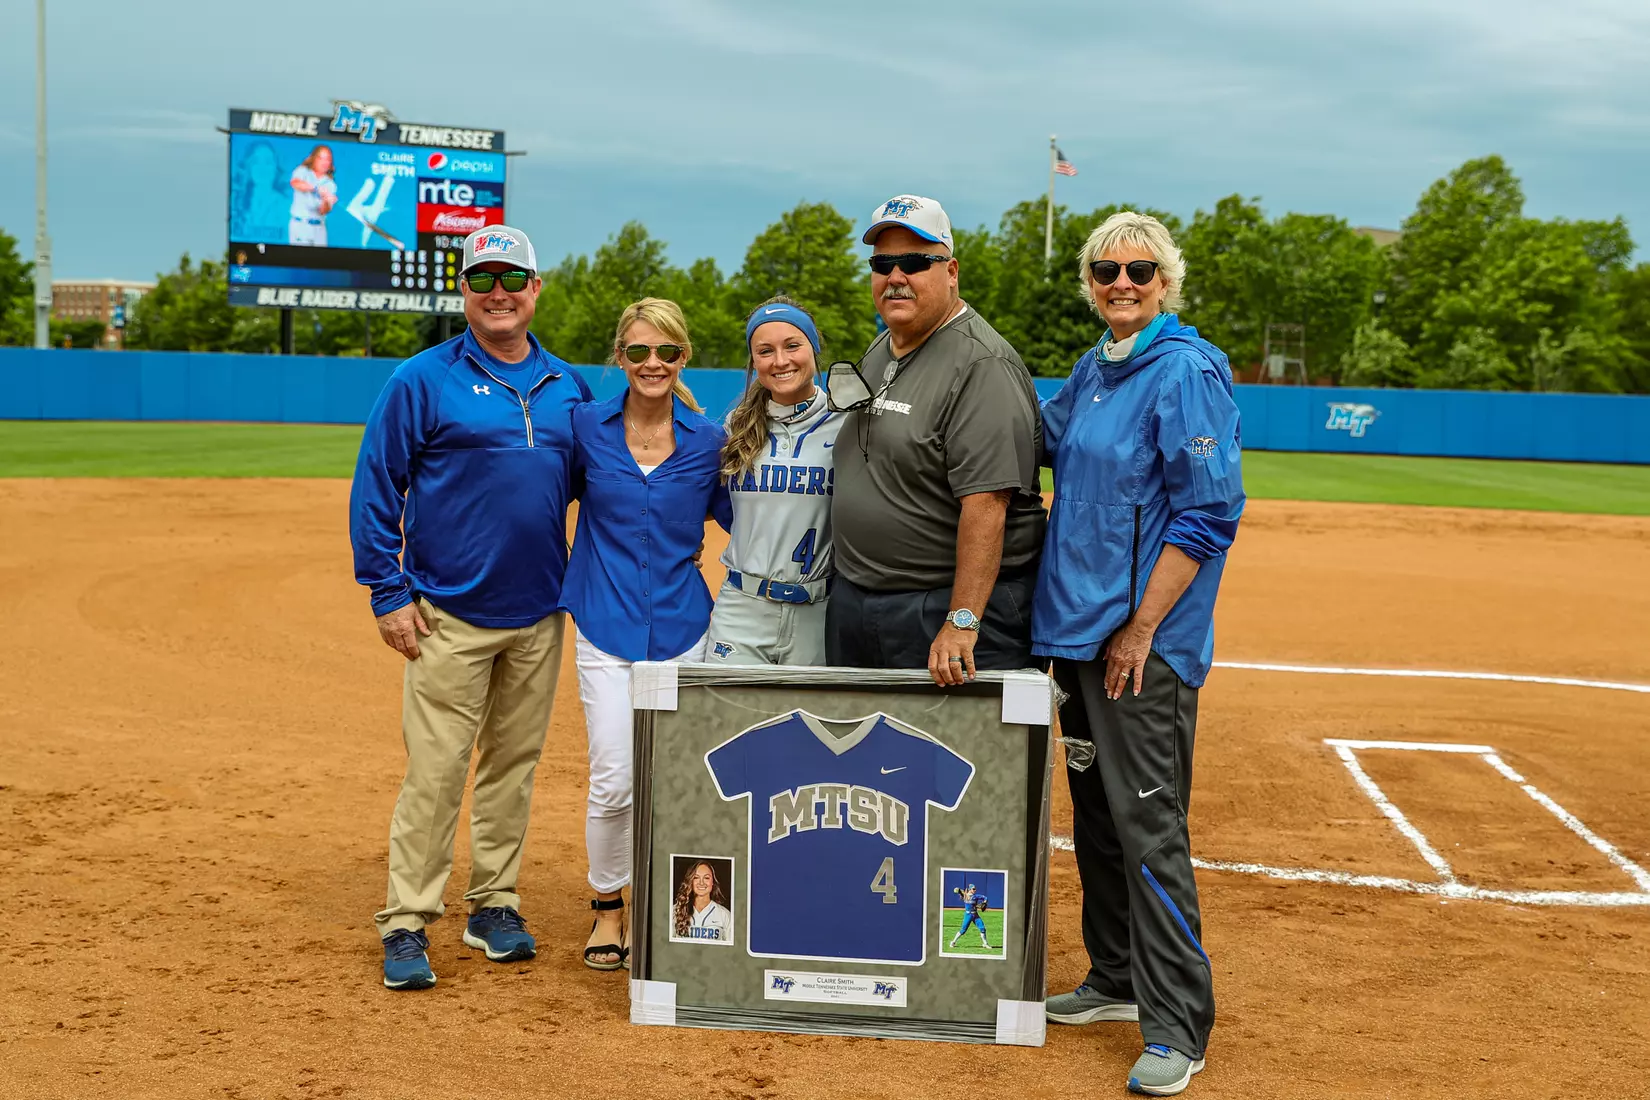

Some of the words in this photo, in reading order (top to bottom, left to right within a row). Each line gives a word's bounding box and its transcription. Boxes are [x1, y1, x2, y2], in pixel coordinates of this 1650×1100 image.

[249, 112, 320, 136] MIDDLE
[329, 102, 388, 143] MT
[399, 124, 494, 150] TENNESSEE
[372, 162, 415, 177] SMITH
[451, 159, 493, 173] pepsi
[419, 179, 475, 207] mte
[882, 199, 914, 218] MT
[433, 211, 486, 229] Ascend
[486, 235, 514, 252] MT
[257, 287, 300, 306] BLUE
[300, 289, 358, 309] RAIDER
[358, 292, 433, 312] SOFTBALL
[435, 295, 465, 313] FIE
[1325, 404, 1375, 438] MT
[1191, 438, 1215, 458] MT
[792, 528, 817, 574] 4
[768, 782, 909, 846] MTSU
[870, 857, 897, 904] 4
[771, 976, 796, 993] MT
[873, 982, 898, 1000] MT
